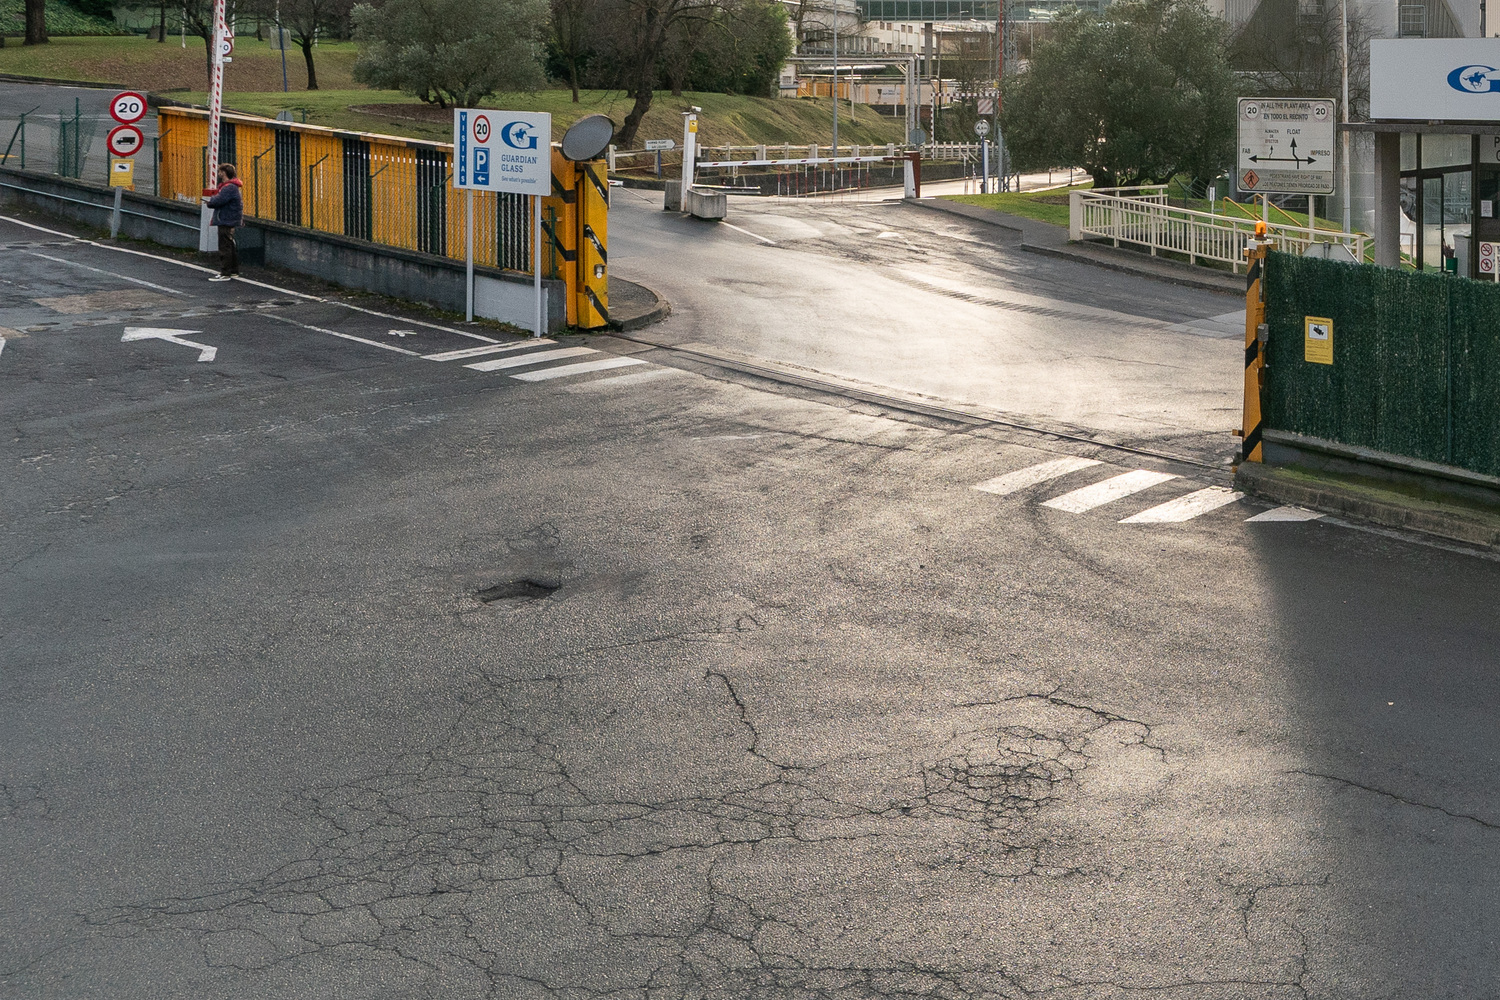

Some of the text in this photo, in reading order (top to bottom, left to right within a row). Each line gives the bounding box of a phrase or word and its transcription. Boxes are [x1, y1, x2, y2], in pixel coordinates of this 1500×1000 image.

[118, 102, 139, 113] 20
[1284, 102, 1298, 110] PLANT
[1315, 107, 1326, 115] 20
[476, 124, 488, 135] 20
[476, 151, 487, 171] P
[501, 154, 537, 164] GUARDIAN
[501, 164, 523, 173] GLASS
